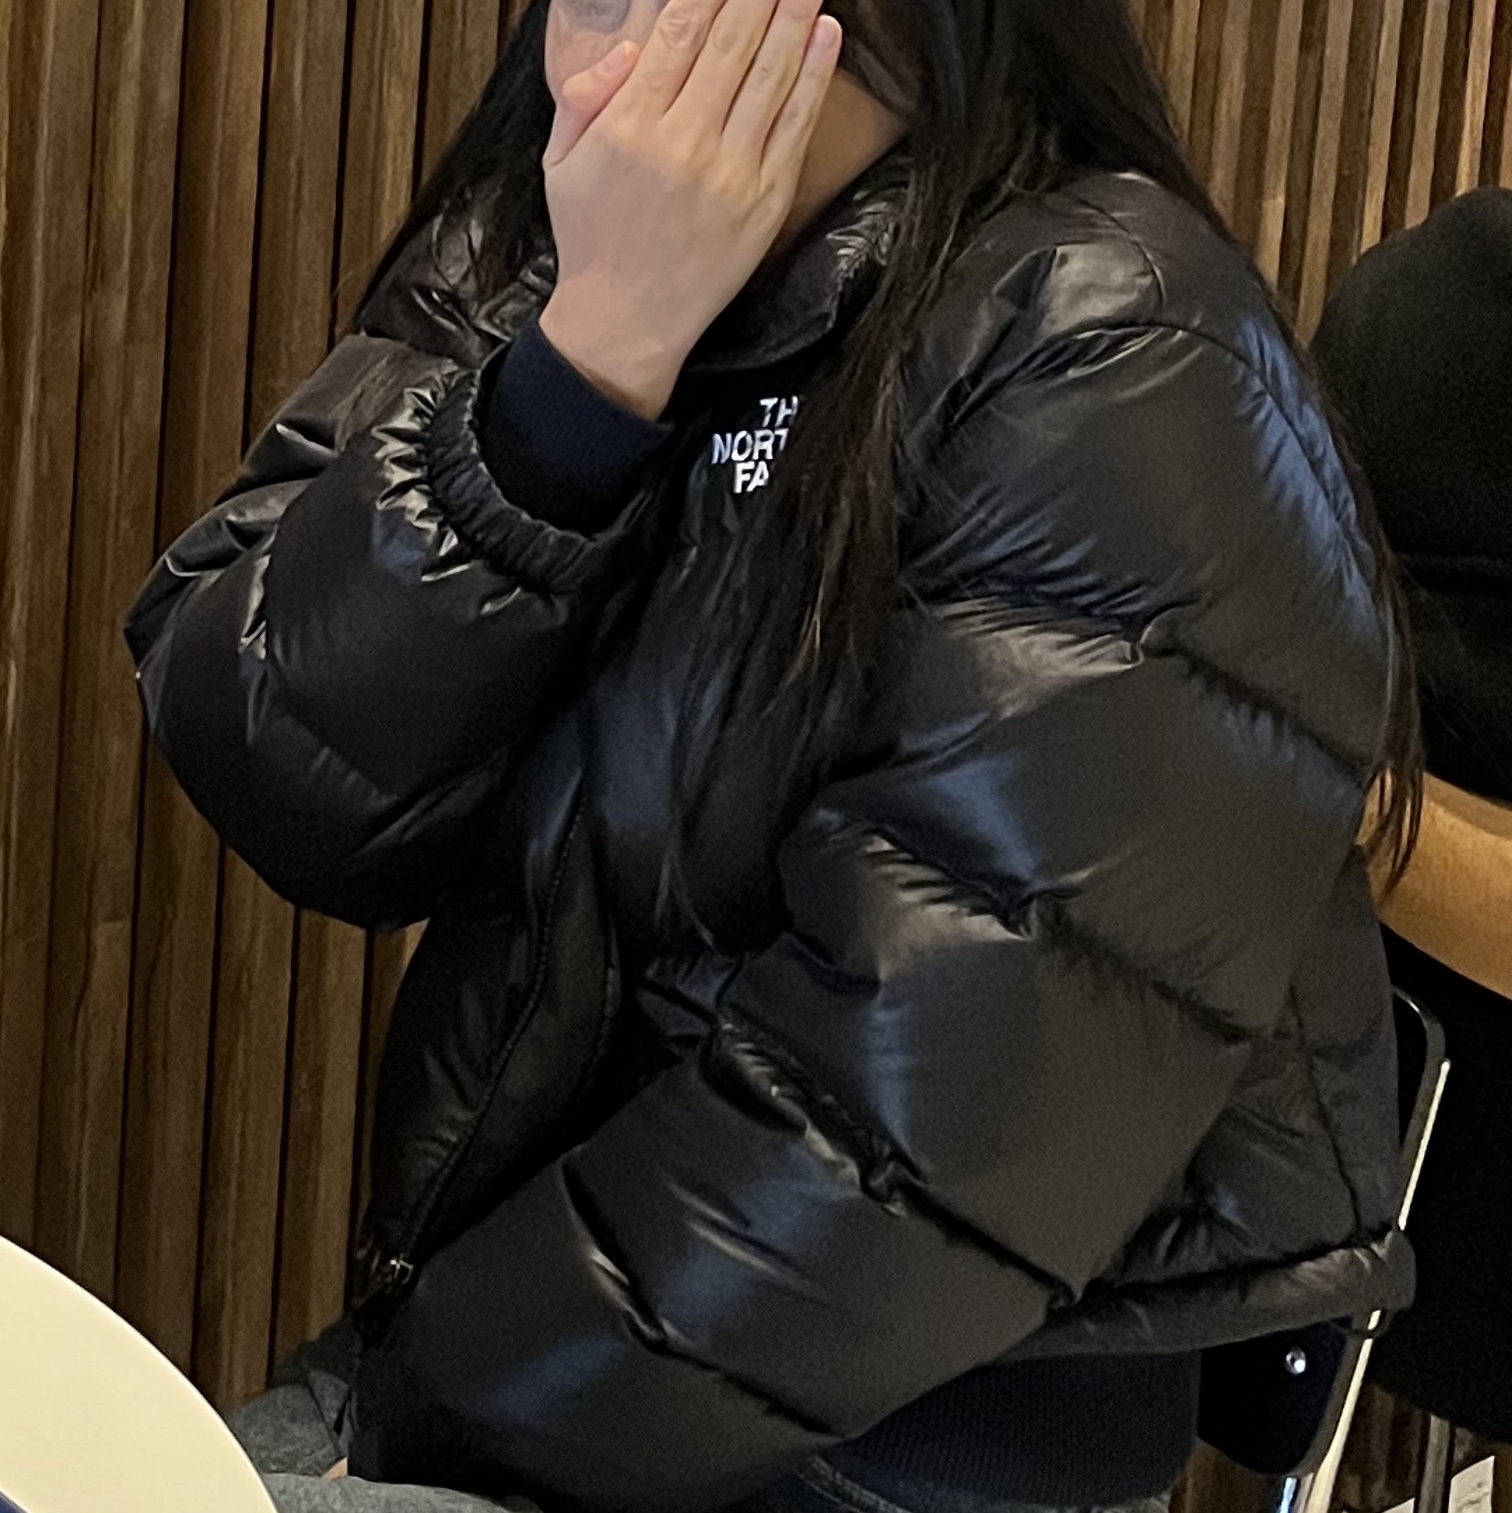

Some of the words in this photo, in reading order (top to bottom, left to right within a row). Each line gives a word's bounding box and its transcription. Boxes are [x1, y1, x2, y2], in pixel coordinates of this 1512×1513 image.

[759, 395, 799, 427] TH
[712, 428, 788, 464] NORT
[733, 461, 769, 493] FA
